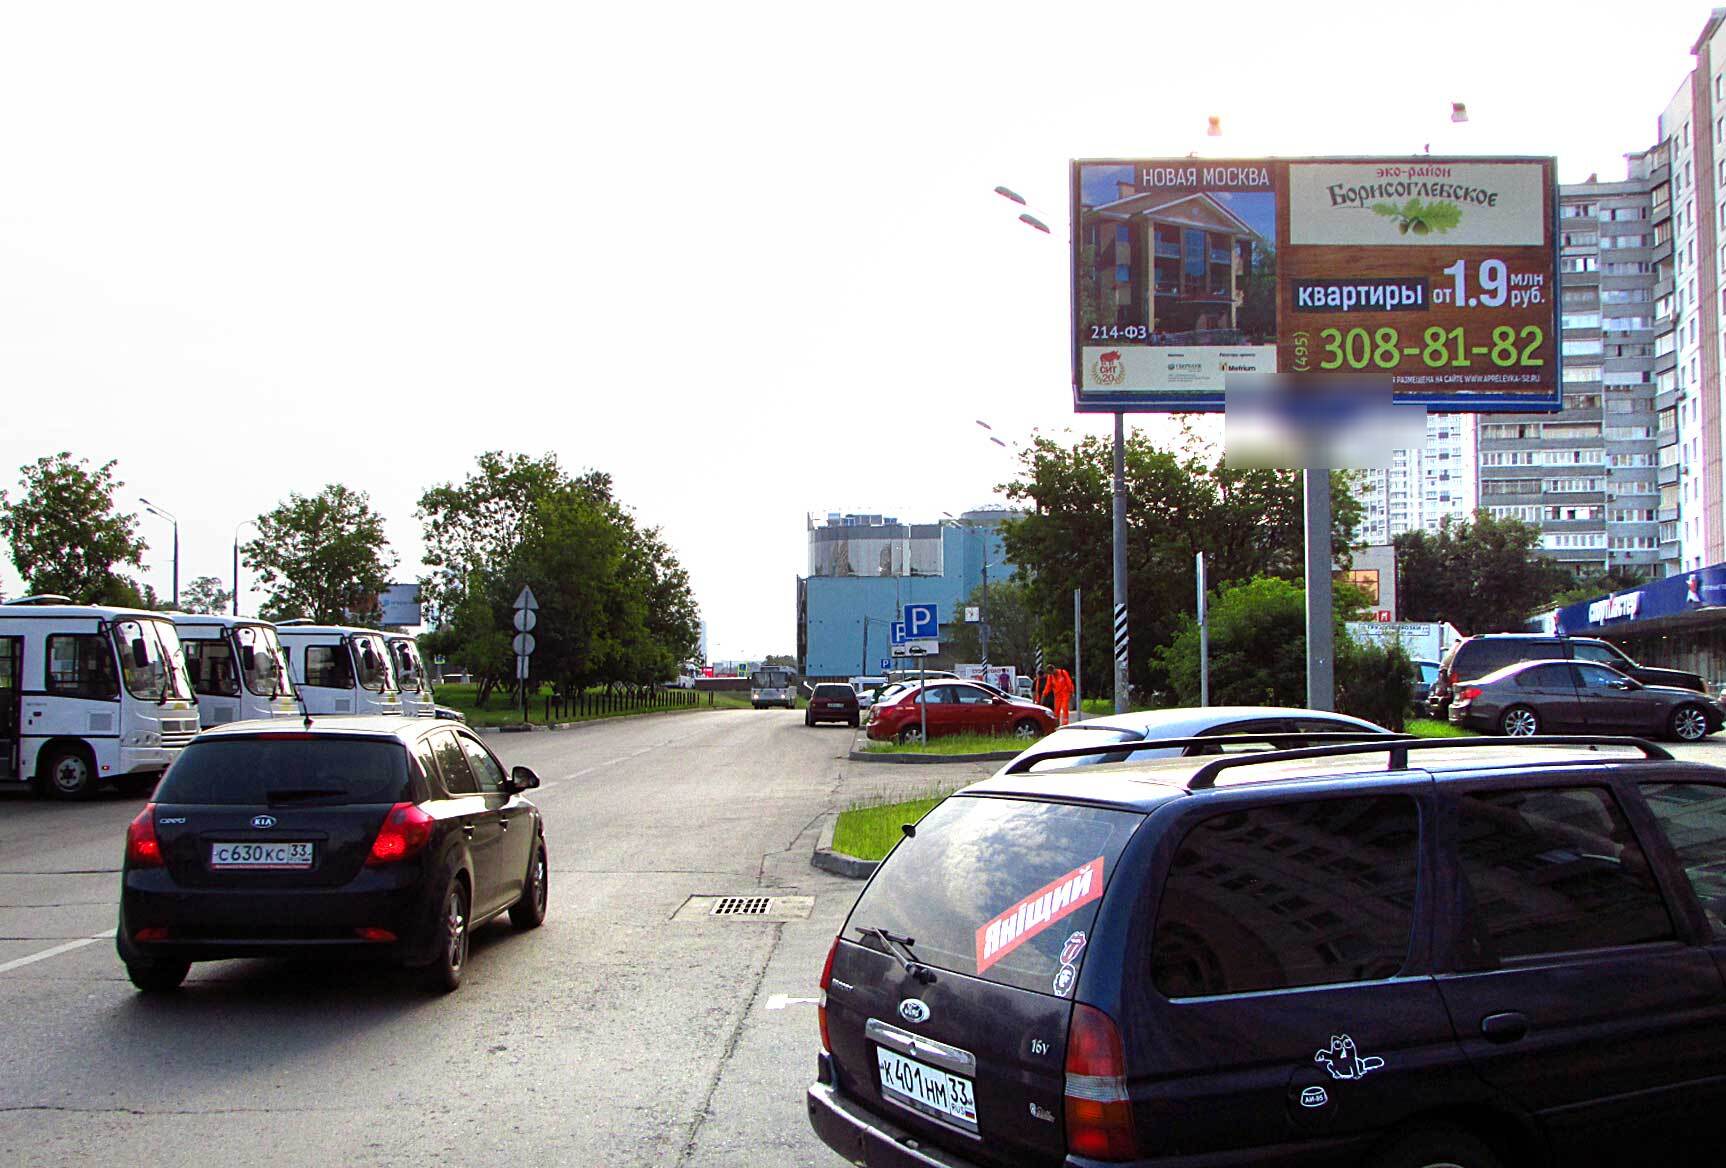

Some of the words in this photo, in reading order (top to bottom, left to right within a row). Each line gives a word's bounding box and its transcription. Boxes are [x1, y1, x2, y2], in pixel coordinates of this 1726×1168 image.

[1142, 168, 1197, 186] НОВАЯ
[1203, 167, 1270, 186] МОСКВА
[1376, 165, 1451, 180] эко-район
[1298, 284, 1423, 311] квартиры
[1433, 287, 1452, 304] от
[1443, 258, 1508, 308] 1.9
[1510, 273, 1544, 286] млн
[1510, 288, 1545, 308] руб.
[1091, 325, 1147, 339] 214-ФЗ
[1292, 331, 1311, 372] (495)
[1320, 325, 1544, 369] 308-81-82
[911, 607, 931, 634] P
[254, 818, 272, 826] KIA
